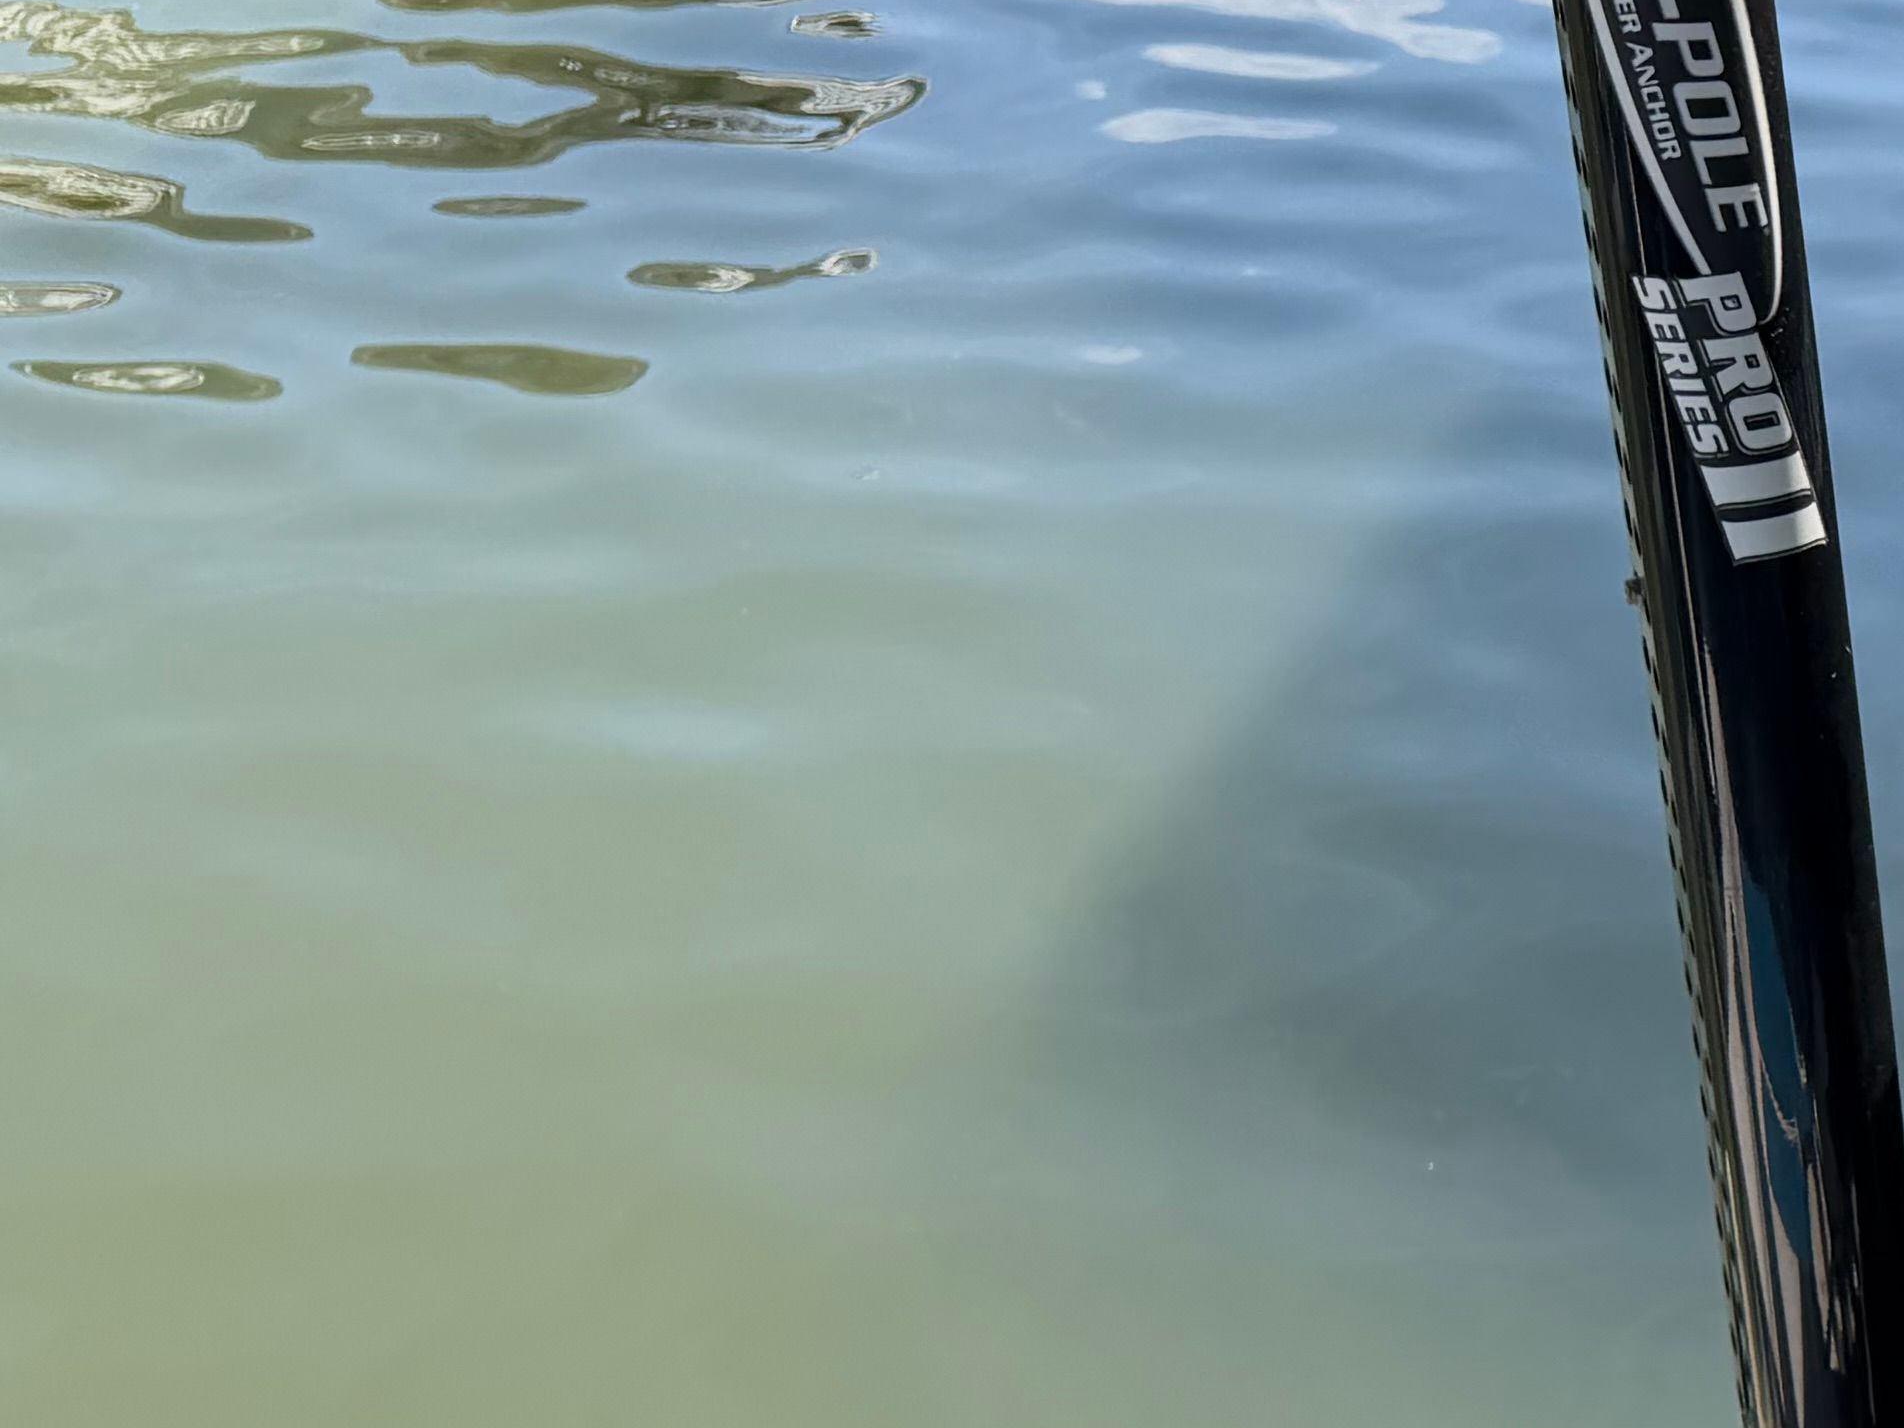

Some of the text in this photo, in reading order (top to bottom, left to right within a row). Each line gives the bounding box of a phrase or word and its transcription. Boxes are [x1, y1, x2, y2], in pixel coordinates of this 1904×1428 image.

[1625, 41, 1681, 162] ANCHOR
[1631, 275, 1730, 459] SERIES
[1674, 271, 1794, 456] PRO
